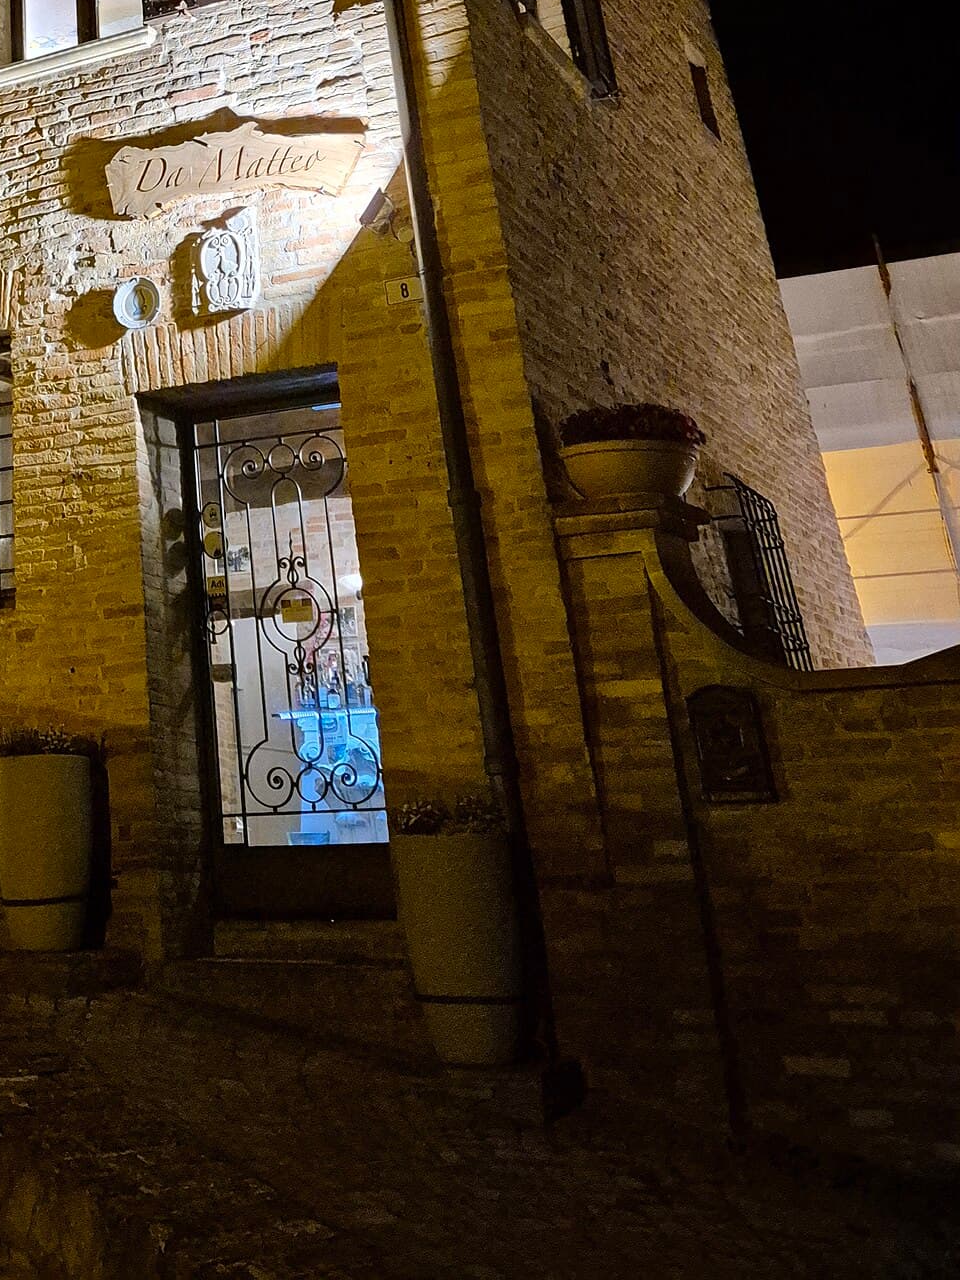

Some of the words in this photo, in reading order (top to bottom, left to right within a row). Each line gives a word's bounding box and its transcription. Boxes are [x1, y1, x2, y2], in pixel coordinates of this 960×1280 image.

[136, 157, 184, 194] Da
[199, 144, 326, 188] Matteo
[400, 283, 409, 298] 8
